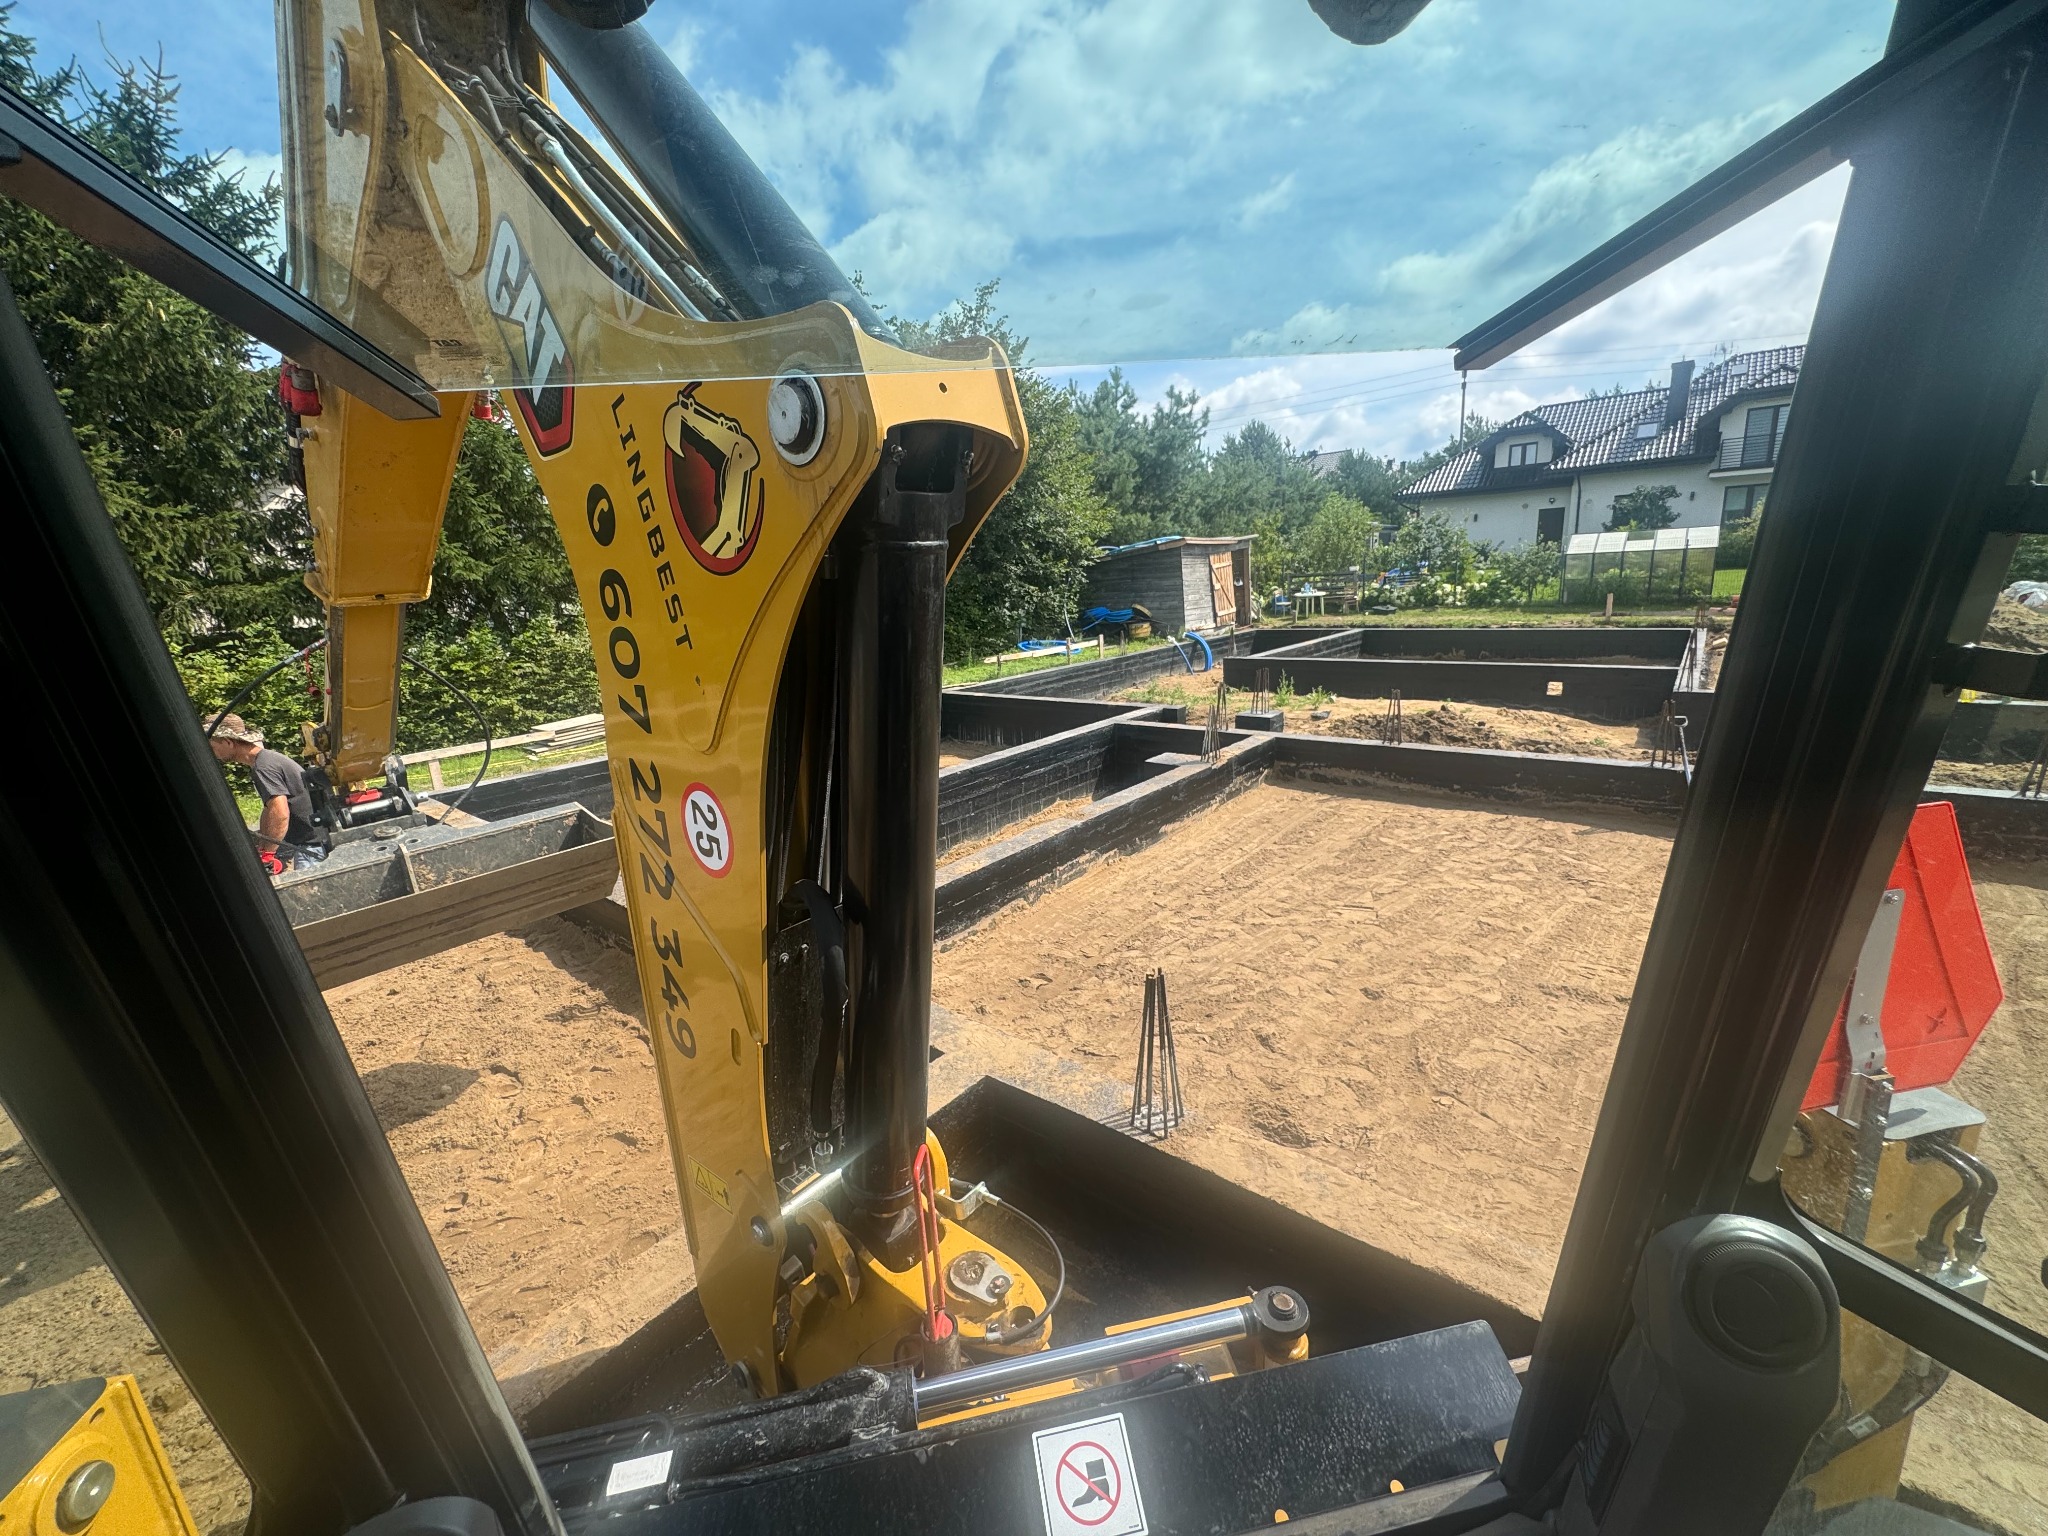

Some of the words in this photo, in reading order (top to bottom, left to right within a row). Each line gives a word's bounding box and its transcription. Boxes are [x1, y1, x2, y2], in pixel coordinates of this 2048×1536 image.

[487, 220, 565, 405] CAT
[611, 393, 692, 650] LINGBEST
[599, 568, 652, 734] 607
[629, 758, 675, 900] 272
[691, 799, 722, 861] 25
[651, 916, 697, 1059] 349
